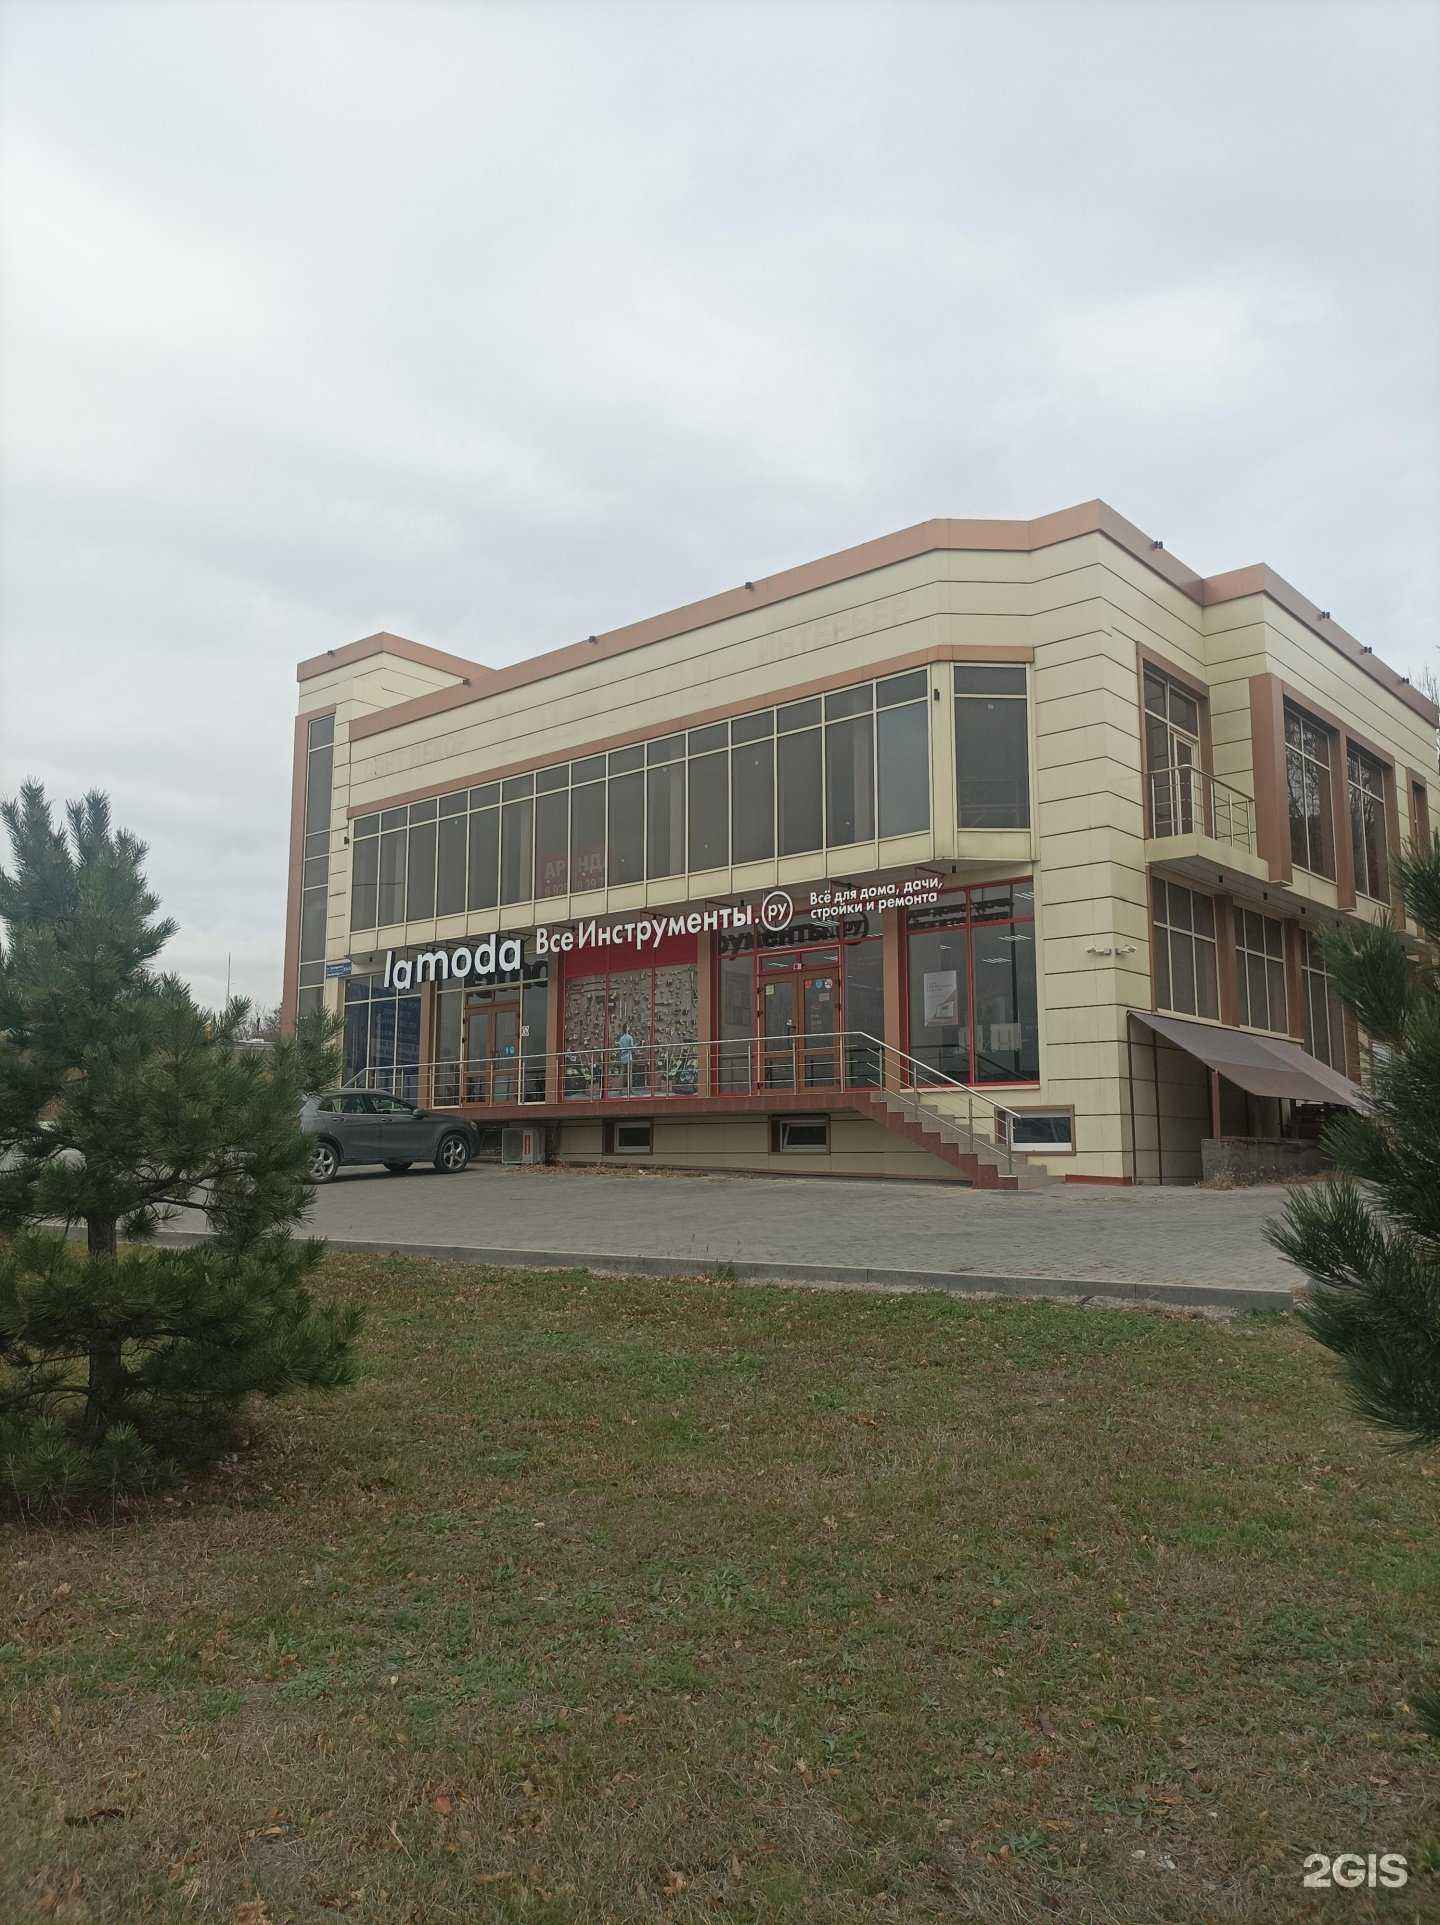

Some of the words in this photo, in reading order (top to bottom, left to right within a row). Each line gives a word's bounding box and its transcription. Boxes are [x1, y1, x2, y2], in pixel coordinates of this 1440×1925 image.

[810, 889, 831, 906] Всё
[834, 888, 857, 905] для
[860, 883, 900, 900] дома,
[904, 877, 943, 894] дачи,
[810, 899, 863, 921] стройки
[866, 900, 875, 912] и
[879, 892, 938, 914] ремонта
[383, 933, 522, 990] lamoda
